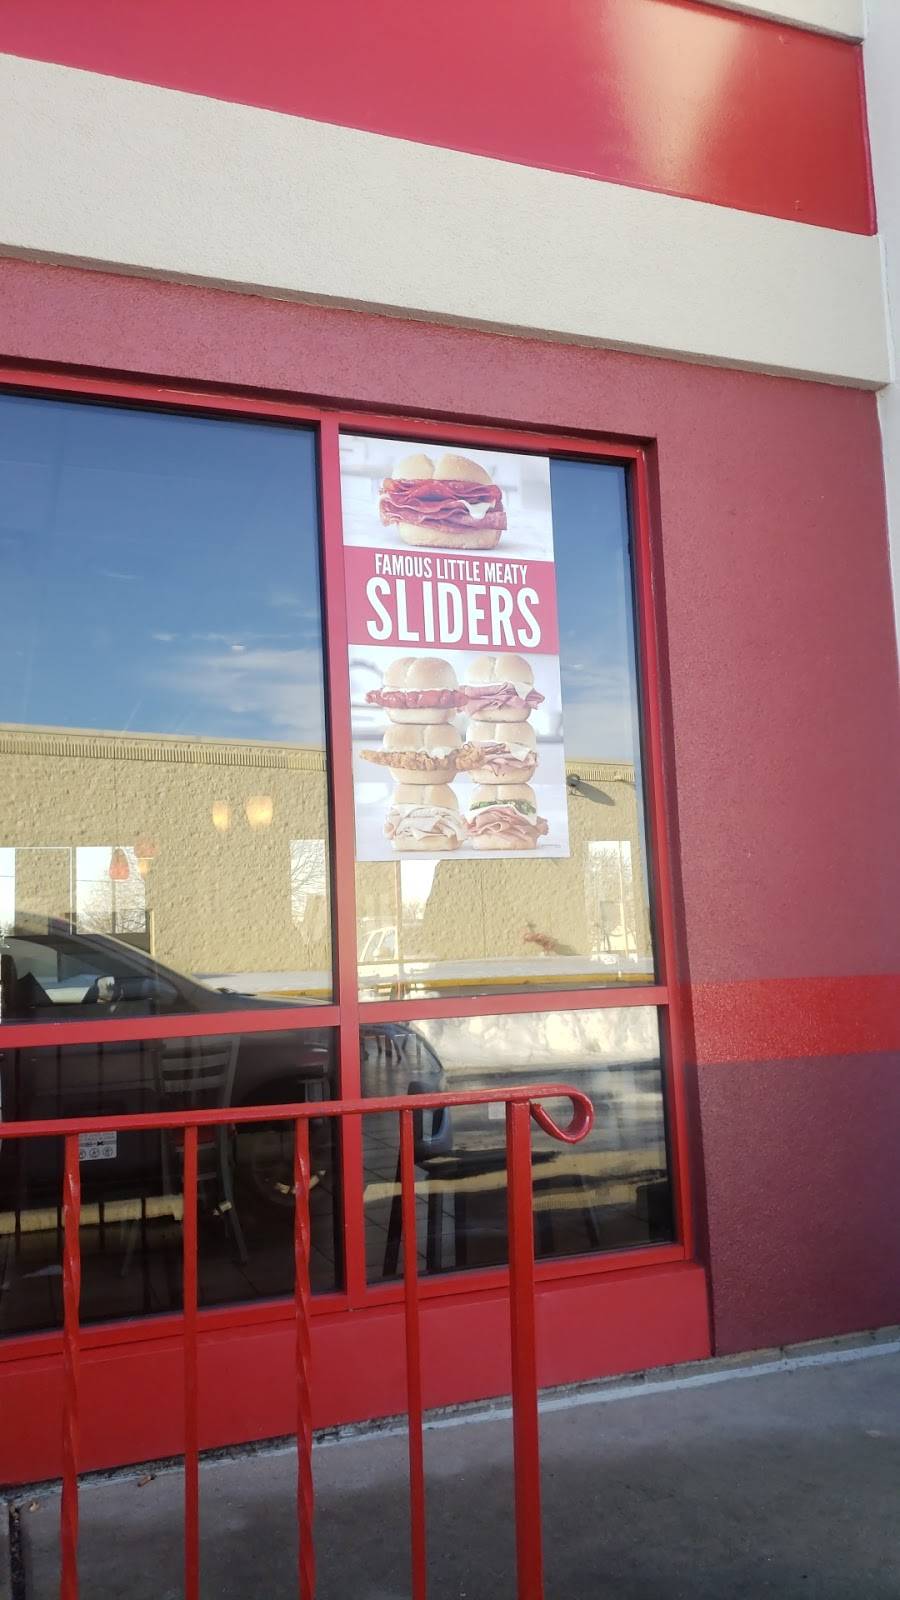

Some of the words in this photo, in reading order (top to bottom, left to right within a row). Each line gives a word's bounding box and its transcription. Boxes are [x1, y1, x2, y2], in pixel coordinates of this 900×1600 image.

[375, 553, 432, 579] FAMOUS
[436, 558, 480, 583] LITTLE
[484, 562, 528, 585] MEATY
[366, 576, 541, 648] SLIDERS
